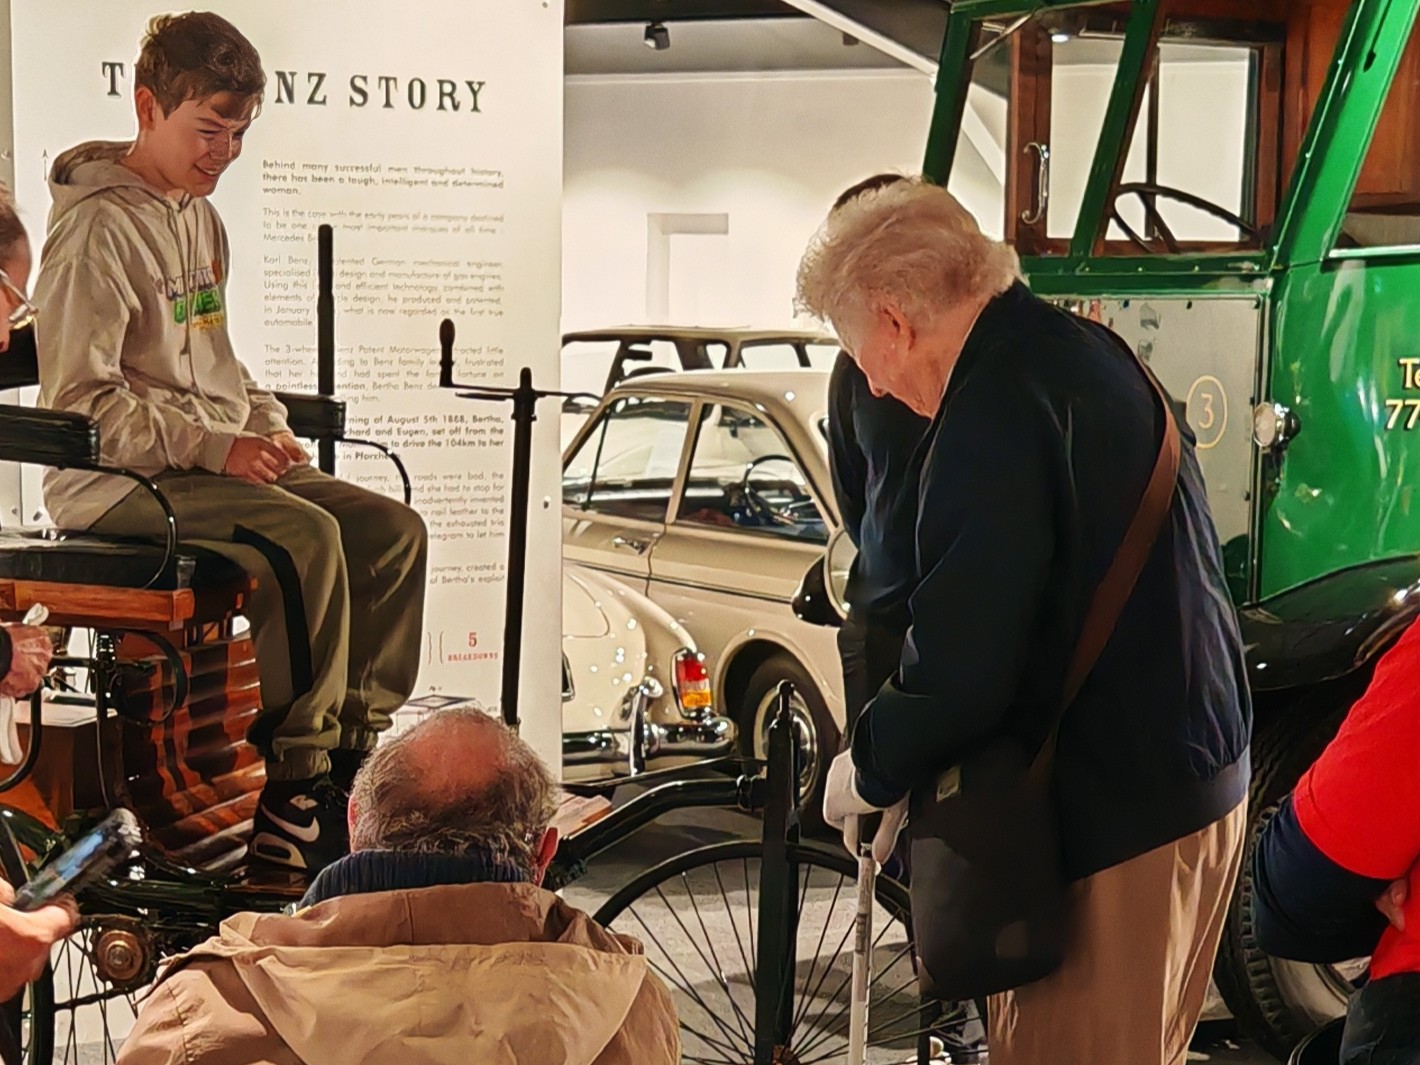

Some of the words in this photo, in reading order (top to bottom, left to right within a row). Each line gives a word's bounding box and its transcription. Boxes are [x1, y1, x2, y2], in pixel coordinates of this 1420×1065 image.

[275, 71, 328, 106] NZ
[349, 75, 486, 113] STORY
[263, 160, 295, 170] Behind
[302, 164, 328, 174] many
[335, 163, 381, 173] successful
[263, 173, 287, 183] there
[291, 173, 308, 183] has
[311, 174, 335, 184] been
[348, 177, 378, 187] tough,
[431, 179, 449, 188] and
[263, 208, 280, 217] This
[263, 233, 304, 242] Mercedes
[264, 255, 281, 264] Karl
[264, 269, 310, 278] specialised
[339, 270, 367, 280] design
[264, 280, 289, 291] Using
[264, 293, 302, 301] elements
[276, 306, 310, 316] January
[265, 344, 281, 353] The
[390, 346, 440, 355] Motorwage
[265, 370, 282, 378] that
[1199, 392, 1214, 430] 3
[373, 416, 384, 424] of
[387, 415, 420, 426] August
[375, 428, 393, 436] and
[465, 426, 487, 436] from
[490, 427, 504, 436] the
[403, 440, 426, 449] drive
[428, 440, 442, 448] the
[490, 439, 504, 448] her
[414, 473, 438, 482] roads
[427, 484, 441, 493] she
[429, 531, 464, 541] elegram
[468, 632, 477, 648] 5
